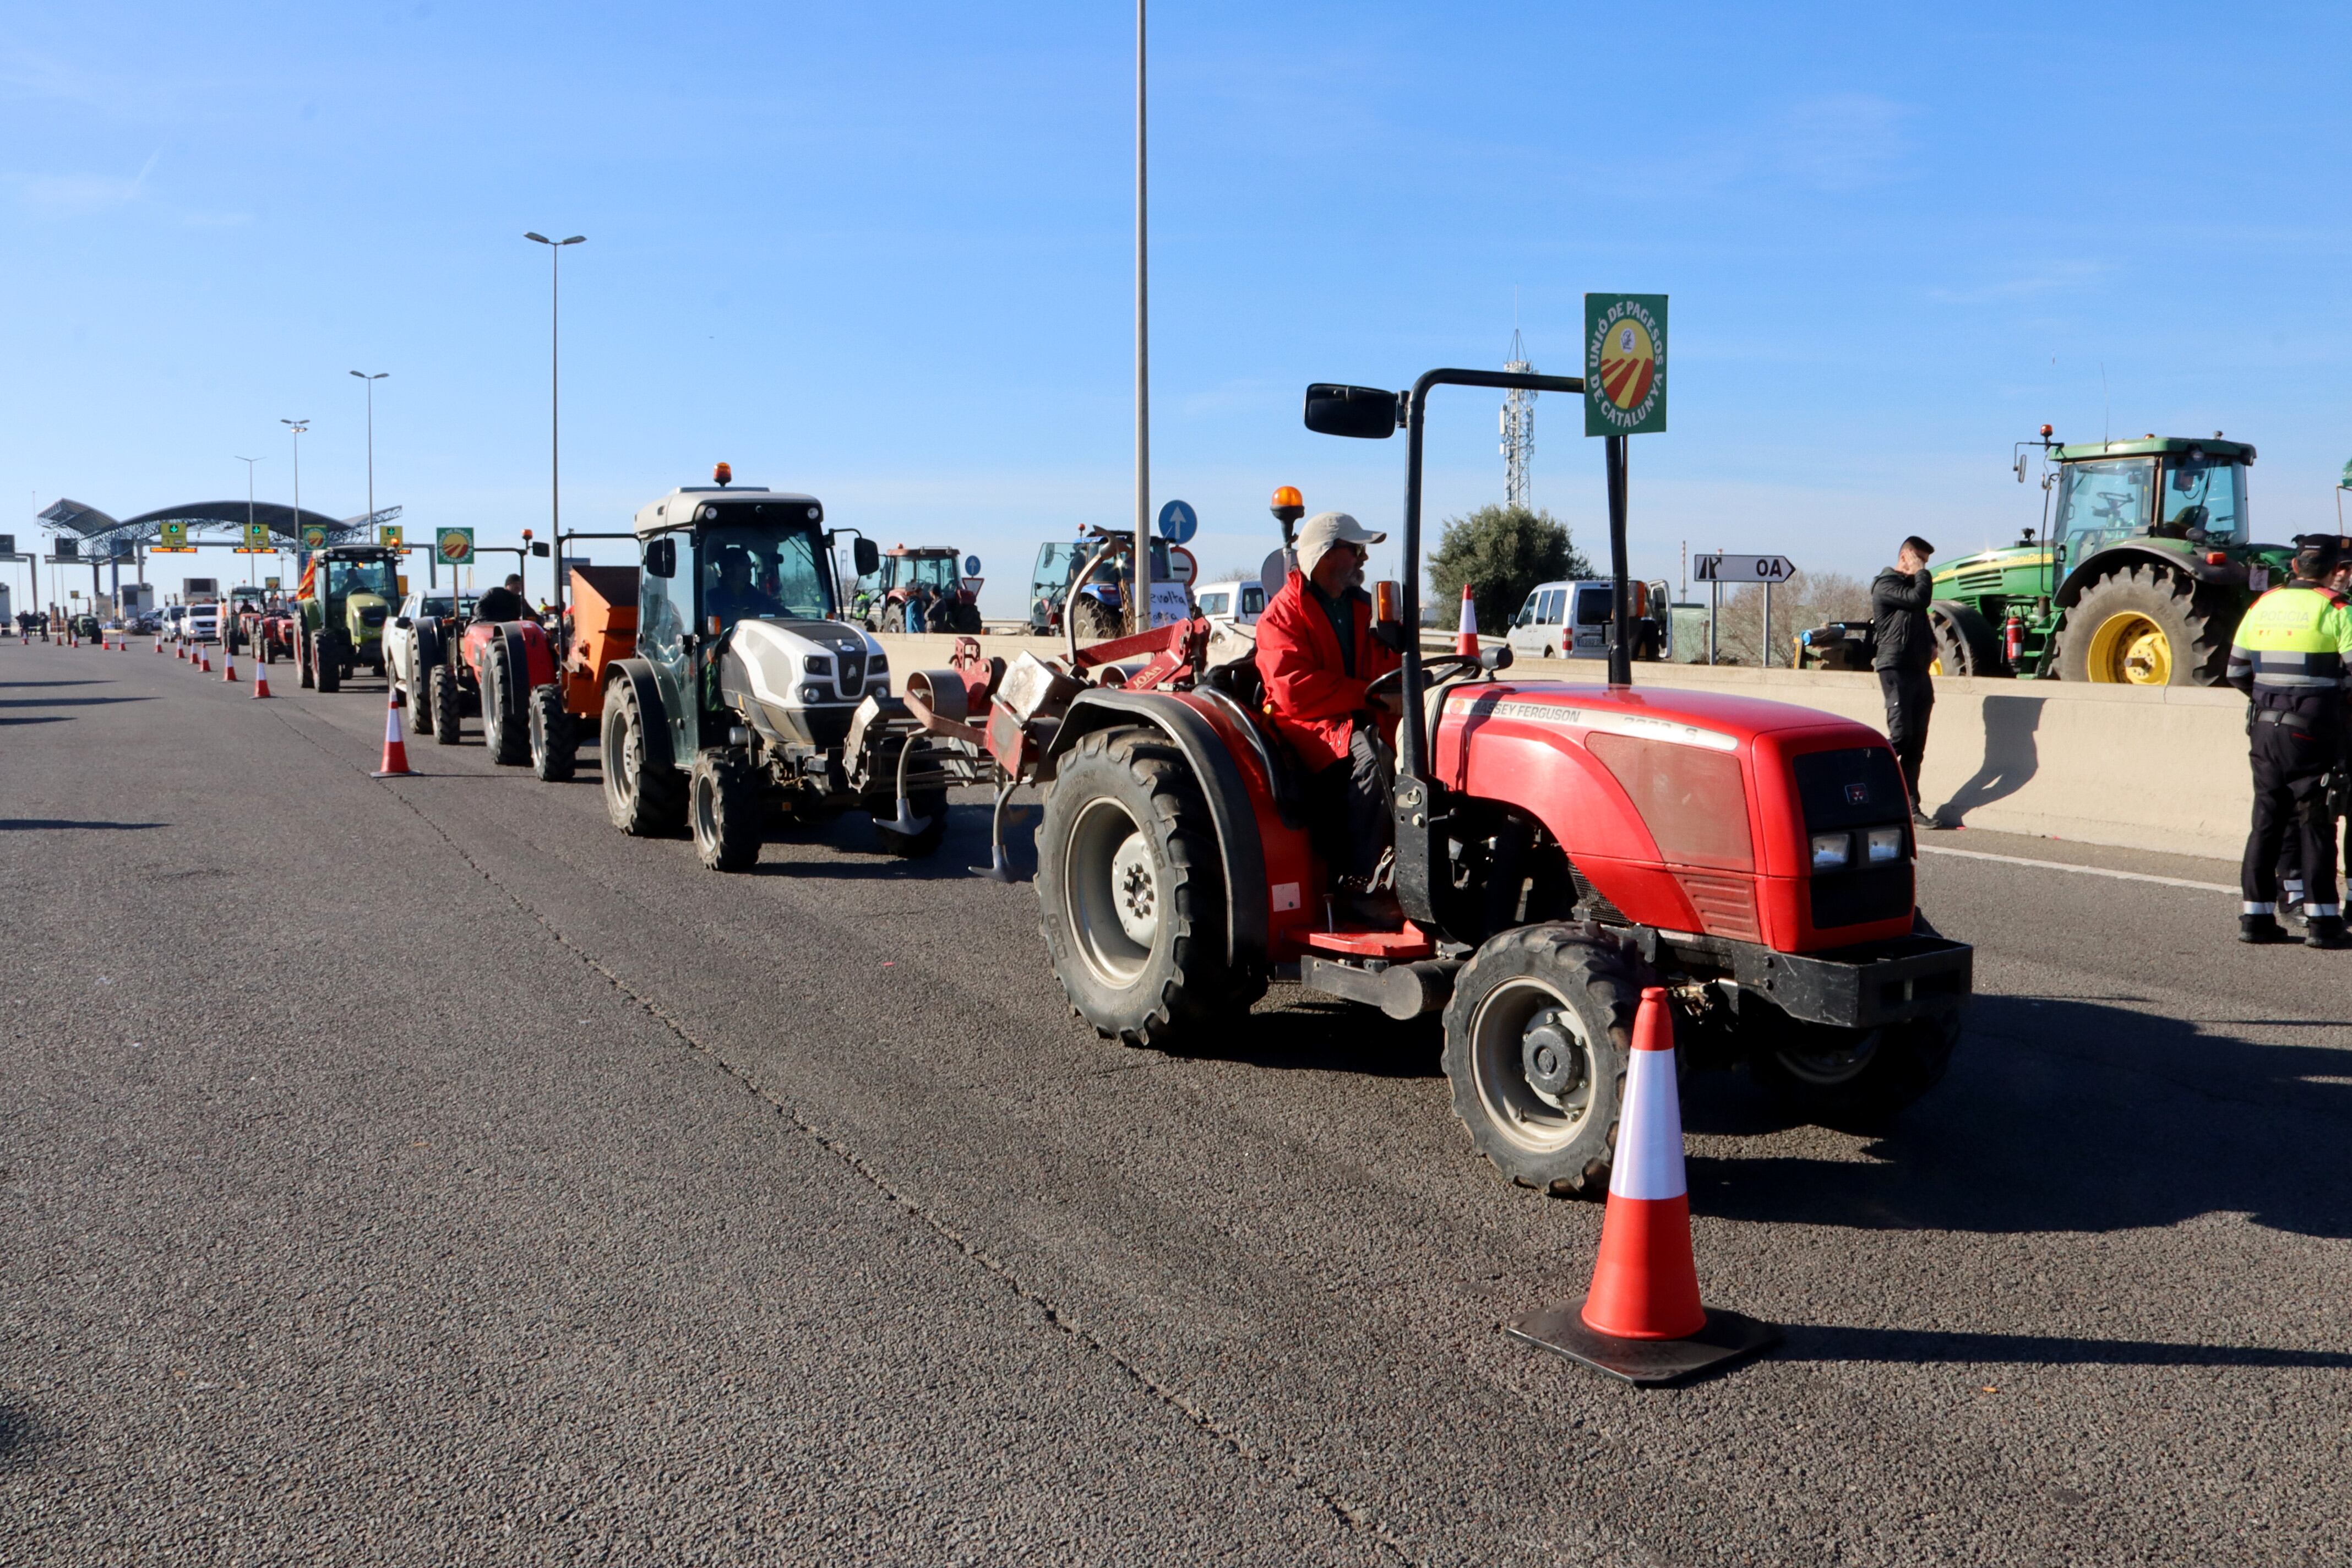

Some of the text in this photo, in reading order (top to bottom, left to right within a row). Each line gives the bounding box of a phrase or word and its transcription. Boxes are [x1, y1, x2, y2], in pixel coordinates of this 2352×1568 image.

[1589, 301, 1663, 367] UNIÓ DE PAGESOS
[1590, 373, 1663, 427] DE CATALUNYA
[1150, 591, 1186, 606] evolta
[2260, 611, 2309, 622] POLICIA
[1133, 666, 1162, 689] JOAN
[1472, 701, 1581, 722] MASSEY FERGUSON
